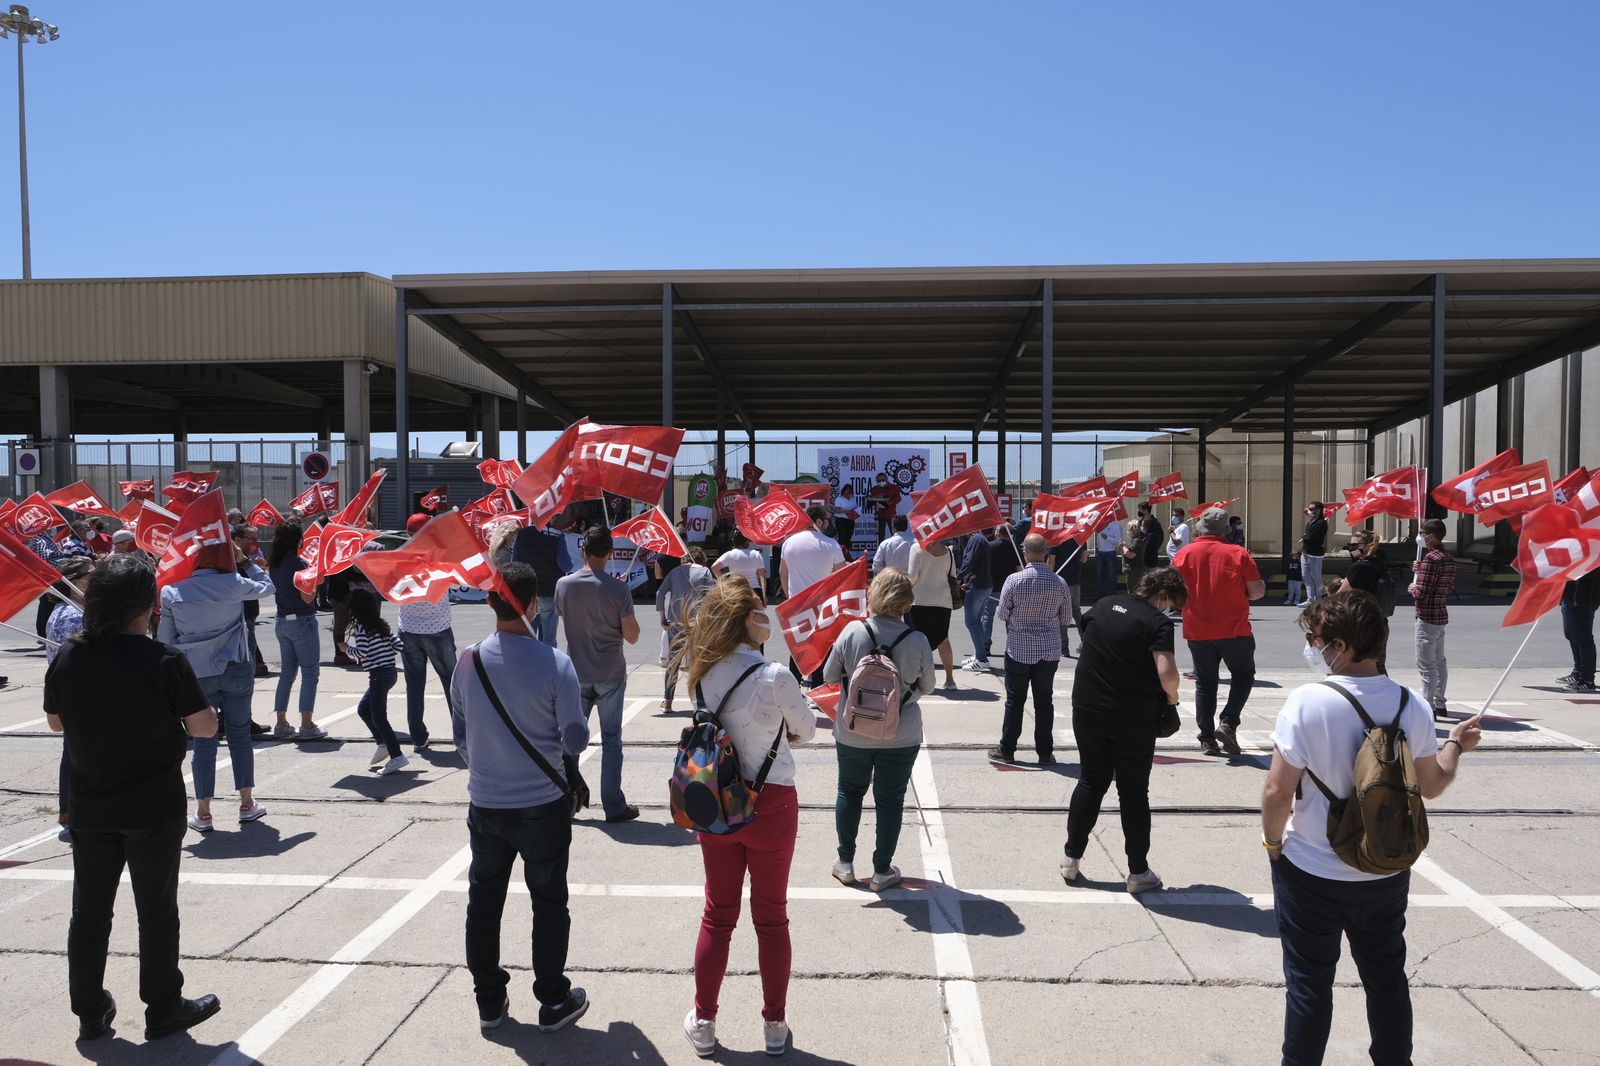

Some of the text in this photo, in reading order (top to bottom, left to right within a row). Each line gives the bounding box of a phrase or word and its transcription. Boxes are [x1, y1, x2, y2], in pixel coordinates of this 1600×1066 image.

[850, 455, 876, 471] AHORA
[850, 477, 873, 496] TOCA
[629, 525, 661, 548] UGT
